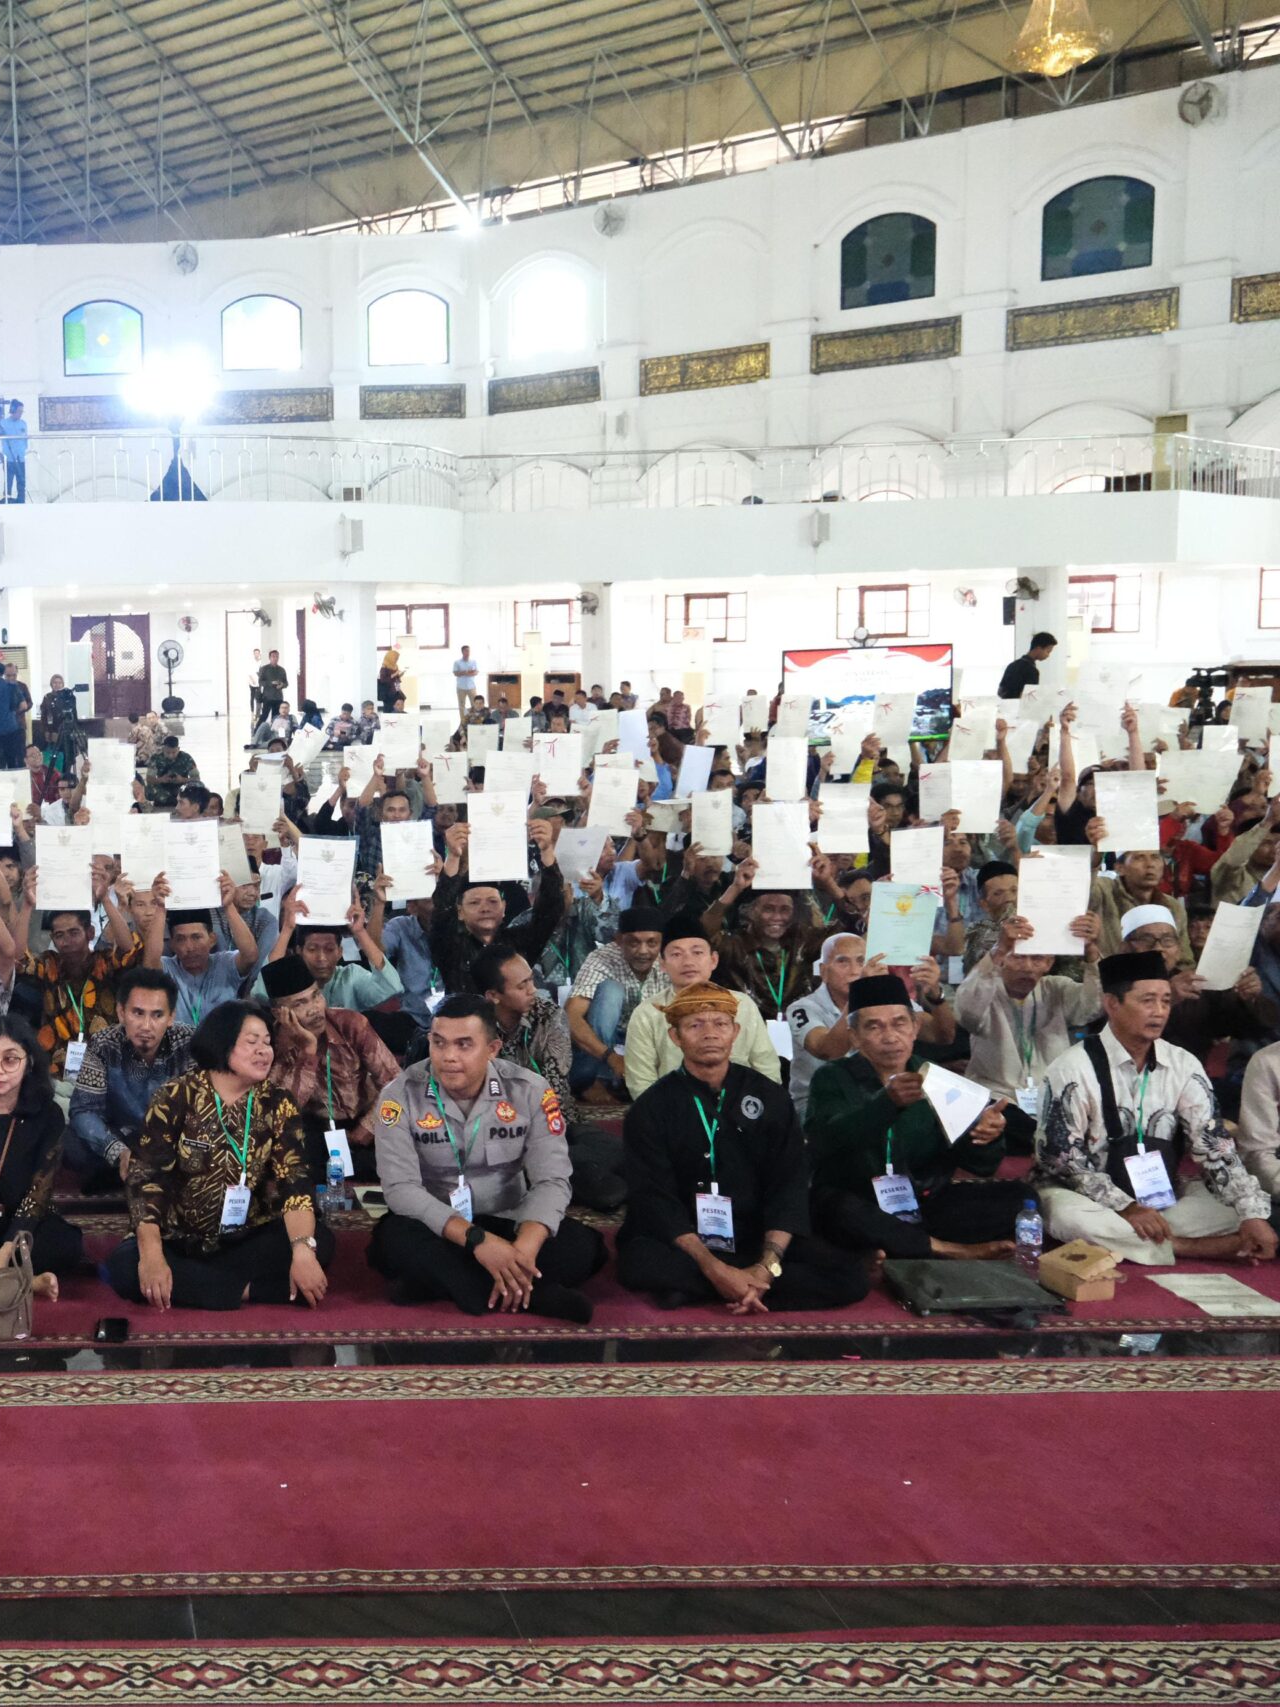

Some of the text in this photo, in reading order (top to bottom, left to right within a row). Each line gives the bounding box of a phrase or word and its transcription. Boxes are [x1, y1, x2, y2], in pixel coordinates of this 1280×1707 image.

[792, 1008, 809, 1028] 3
[489, 1125, 527, 1139] POLRI
[880, 1185, 908, 1194] PESERTA
[702, 1207, 727, 1216] PESERTA
